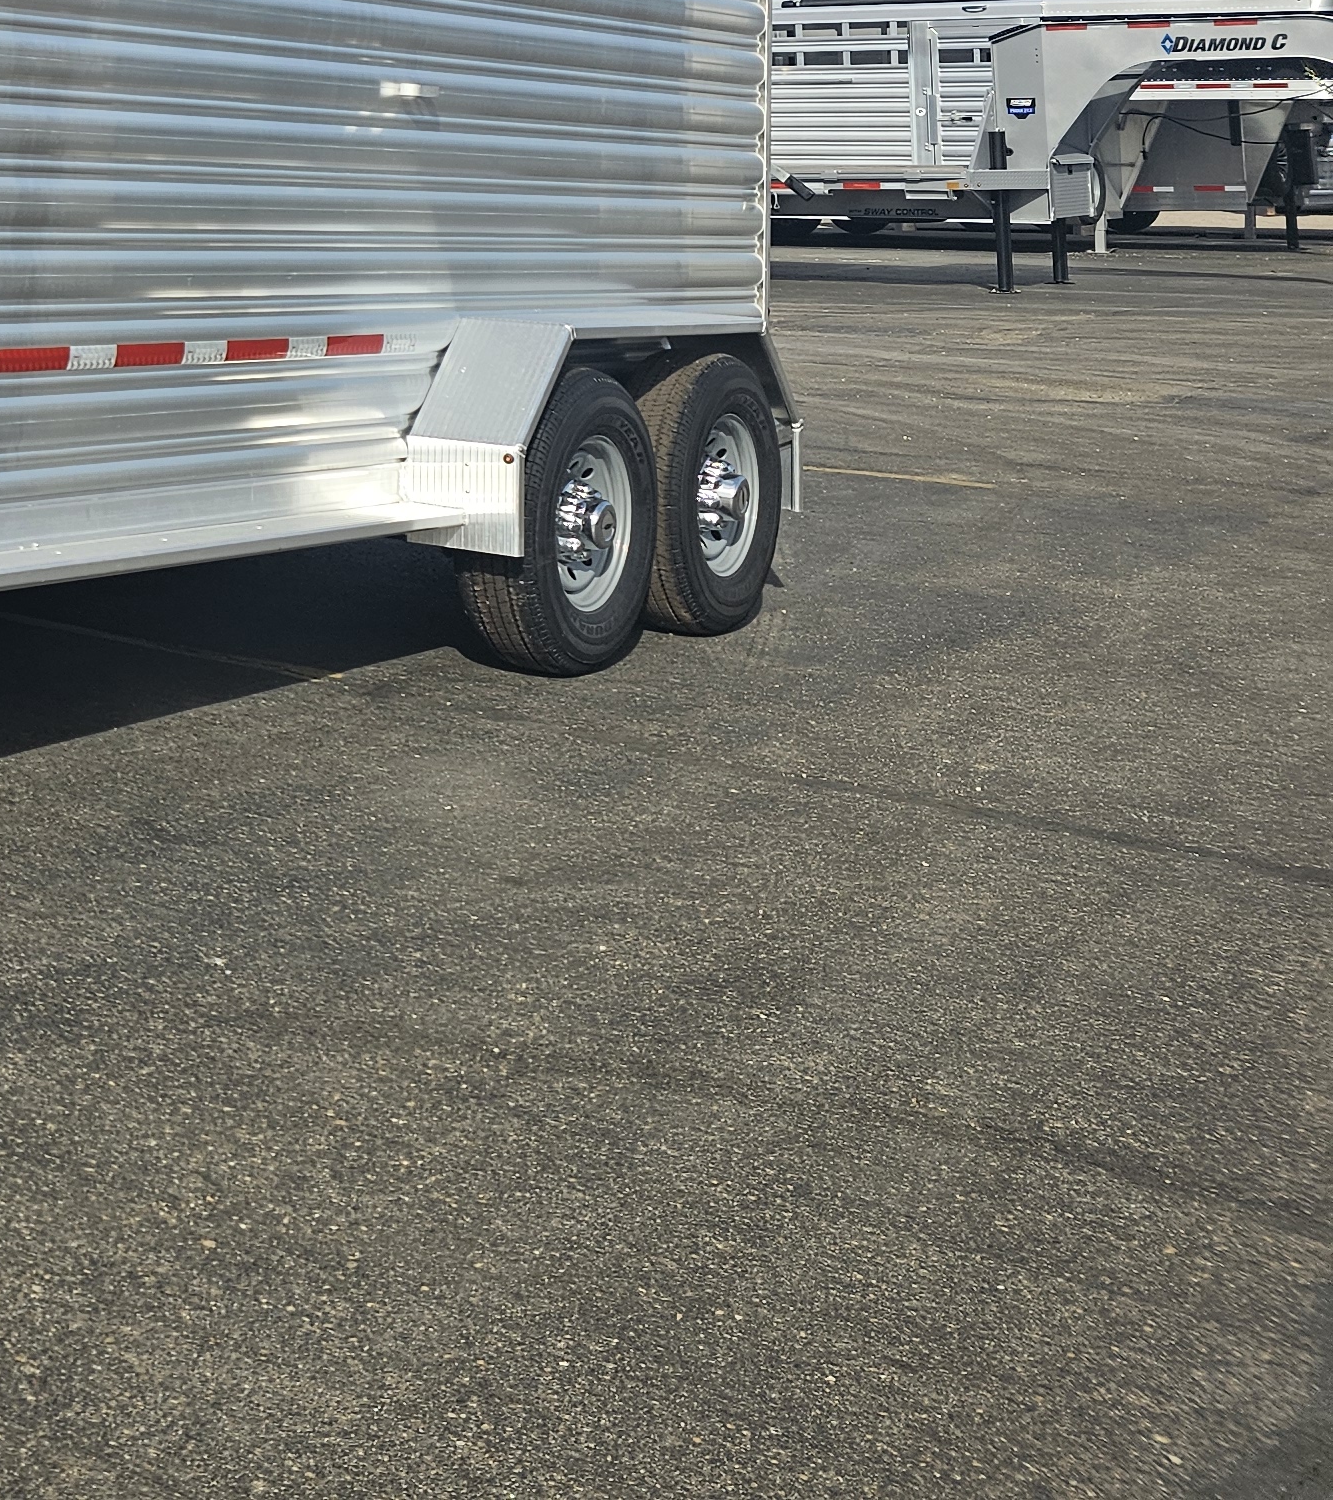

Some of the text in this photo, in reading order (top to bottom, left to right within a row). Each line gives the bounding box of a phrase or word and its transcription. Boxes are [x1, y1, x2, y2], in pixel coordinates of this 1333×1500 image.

[1171, 33, 1288, 52] DIAMOND C
[863, 207, 893, 216] SWAY
[895, 208, 939, 216] CONTROL
